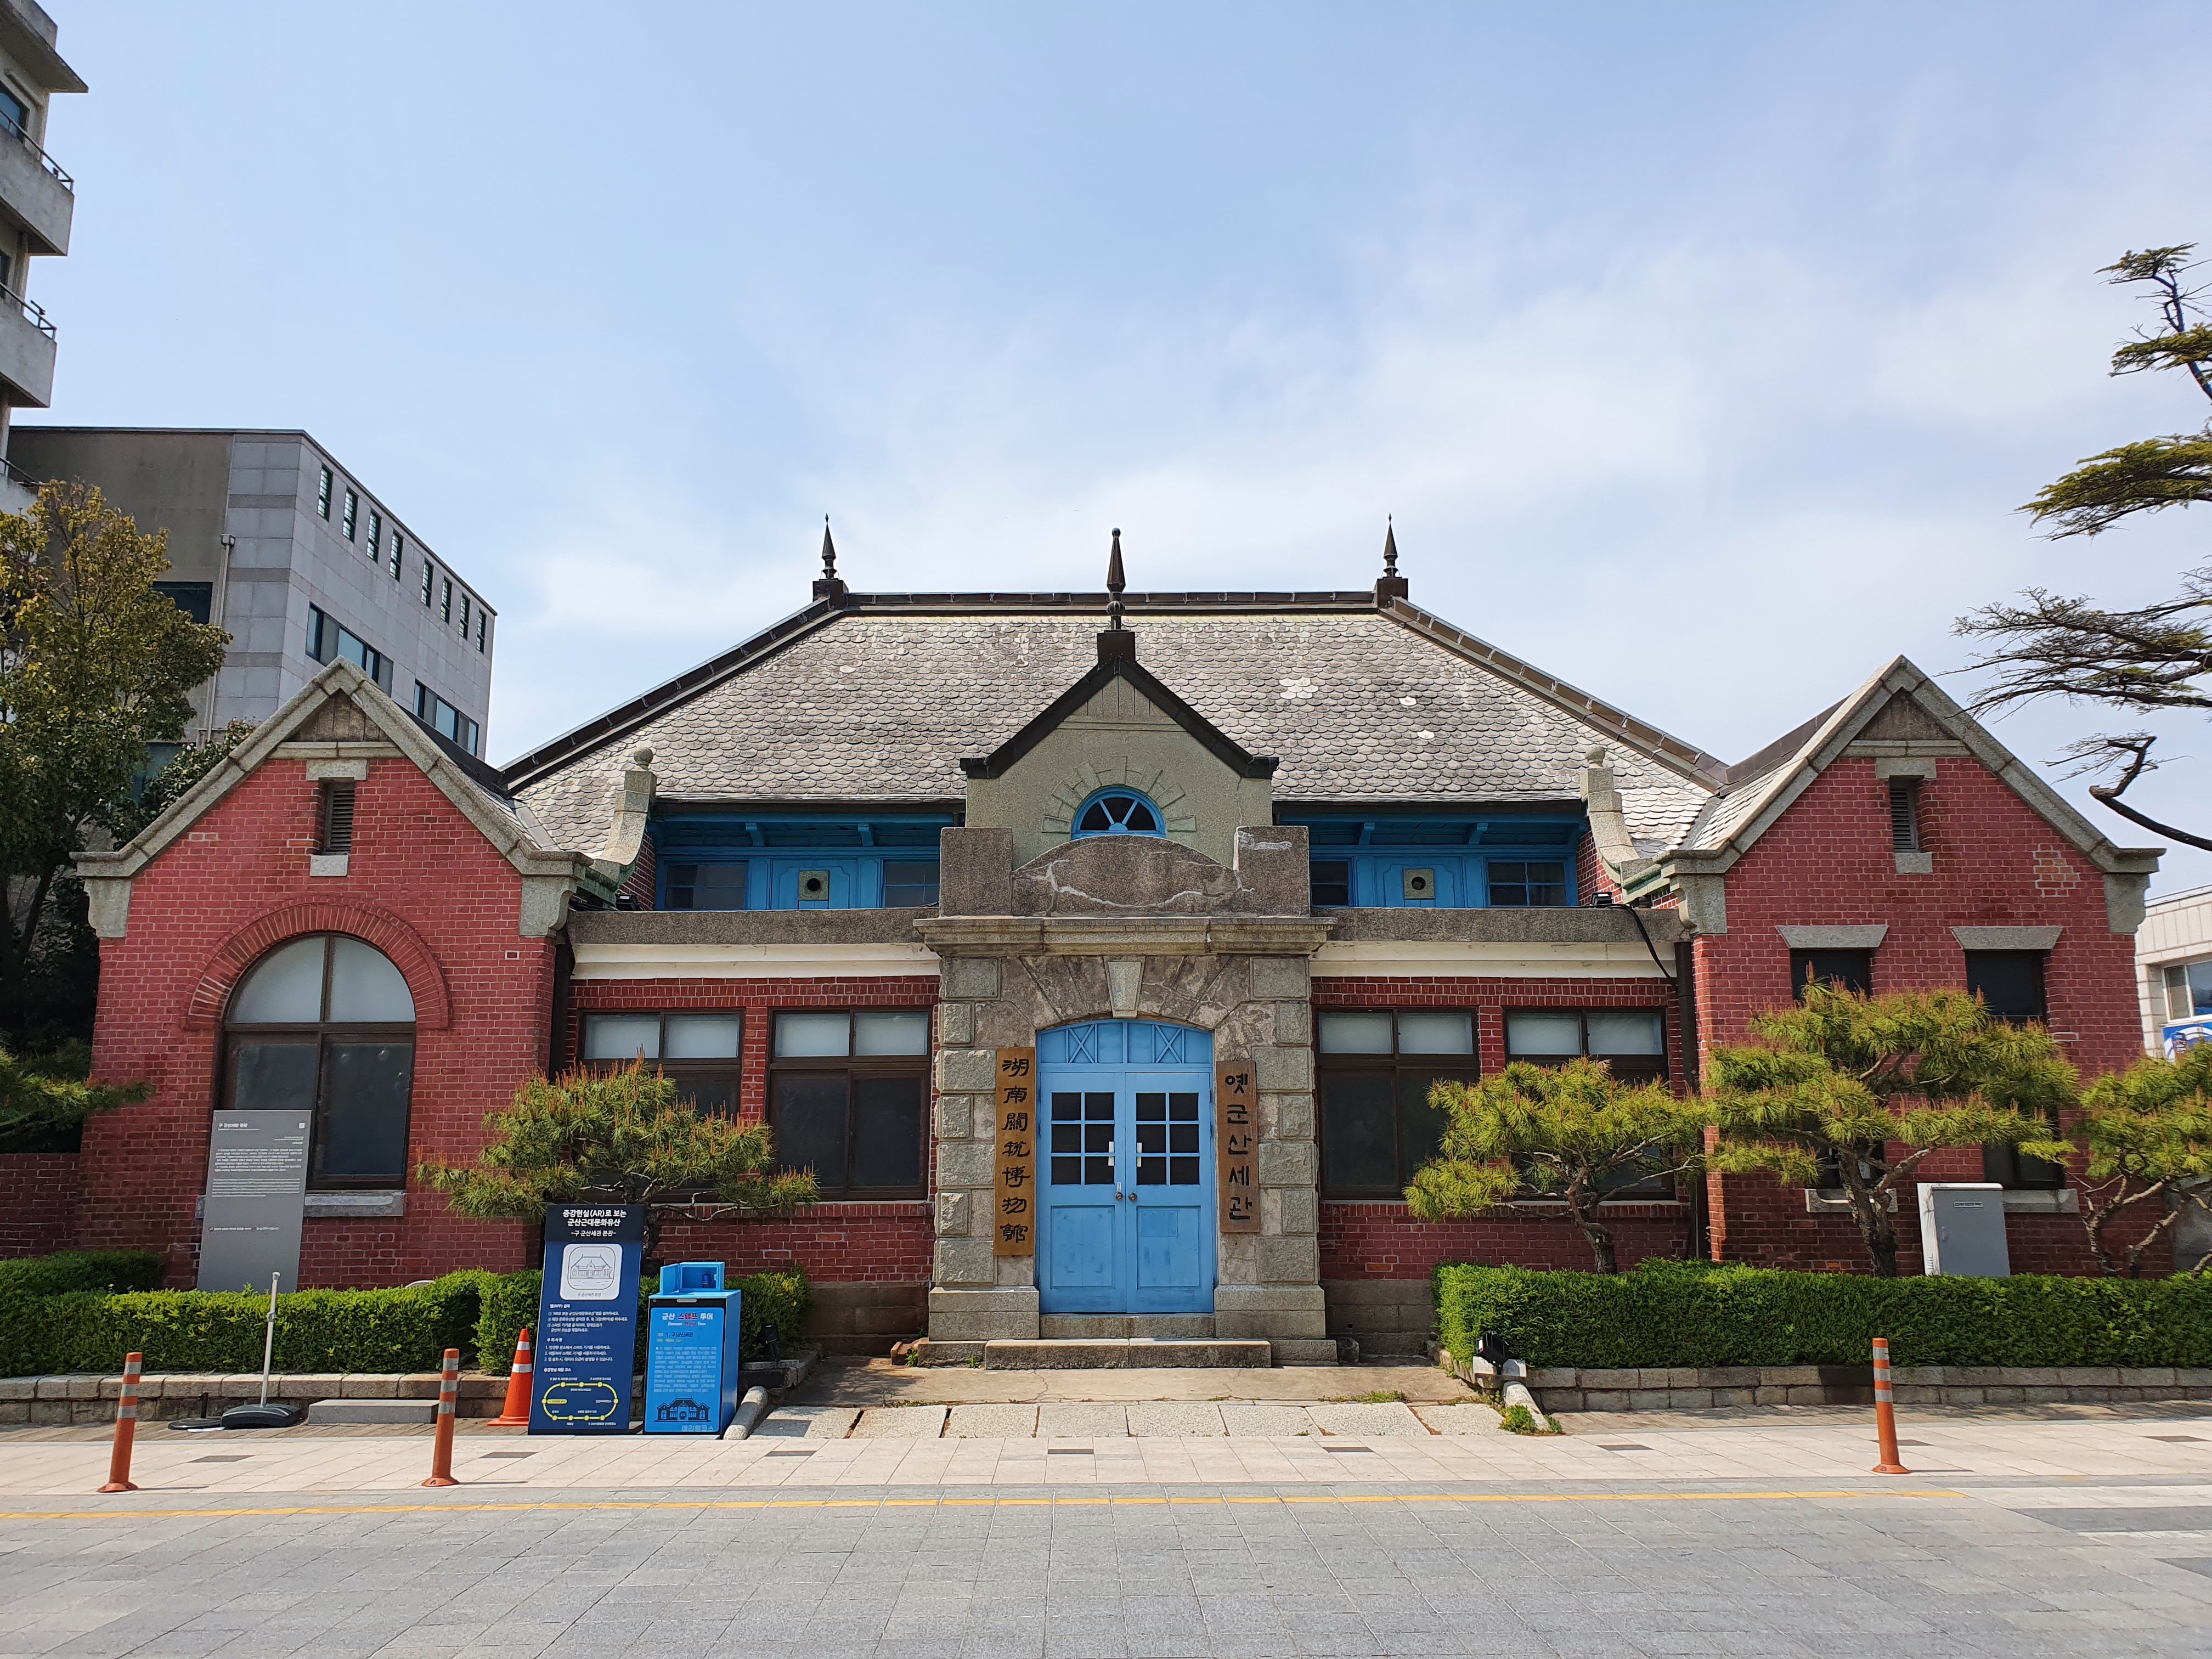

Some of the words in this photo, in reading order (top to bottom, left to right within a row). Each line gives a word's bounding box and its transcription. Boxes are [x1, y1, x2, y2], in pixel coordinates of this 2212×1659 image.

[562, 1209, 612, 1217] 증강현실(AR)로
[613, 1209, 627, 1217] 보는
[567, 1218, 621, 1227] 군산근대문화유산
